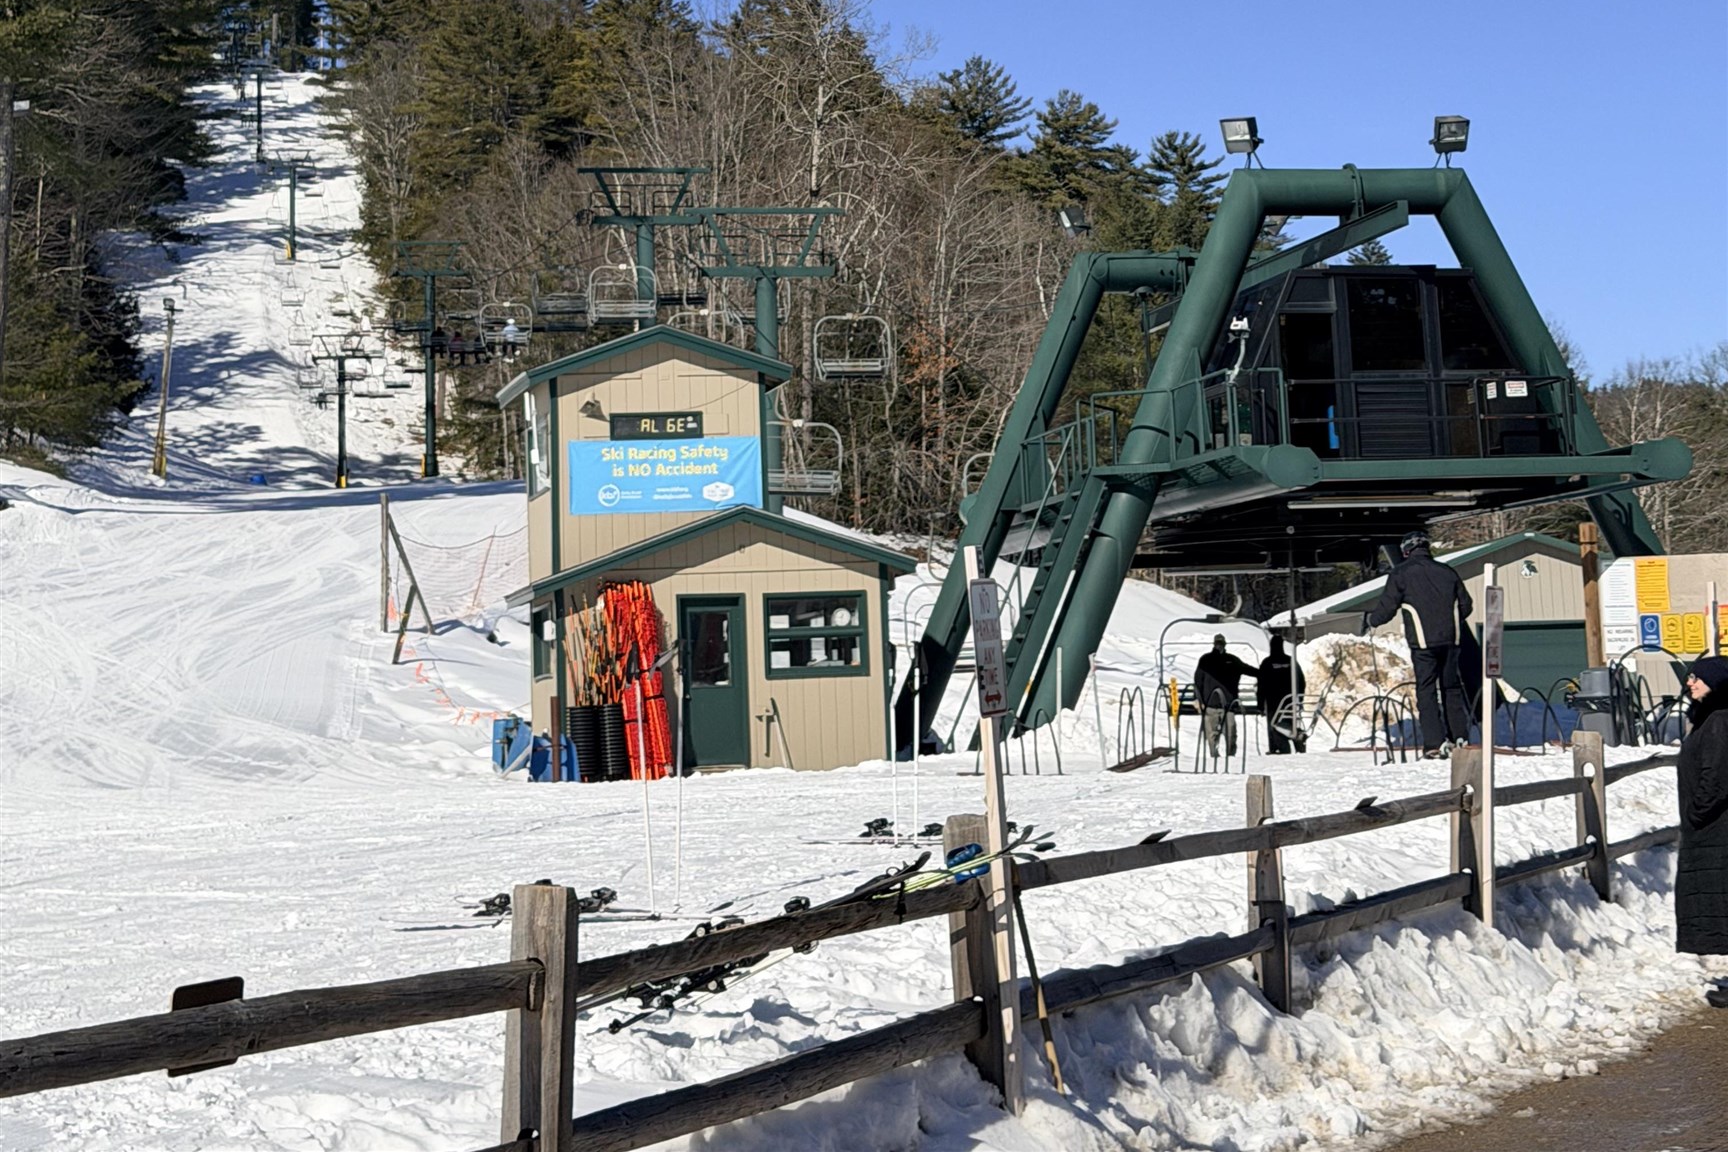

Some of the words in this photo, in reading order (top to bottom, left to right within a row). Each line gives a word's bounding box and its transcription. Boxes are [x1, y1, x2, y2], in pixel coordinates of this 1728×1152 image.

[601, 446, 624, 461] Ski
[628, 445, 676, 462] Racing
[680, 444, 729, 461] Safety
[612, 464, 624, 477] is
[628, 463, 651, 477] NO
[655, 461, 719, 476] Accident
[978, 590, 991, 615] NO
[983, 646, 996, 665] ANY
